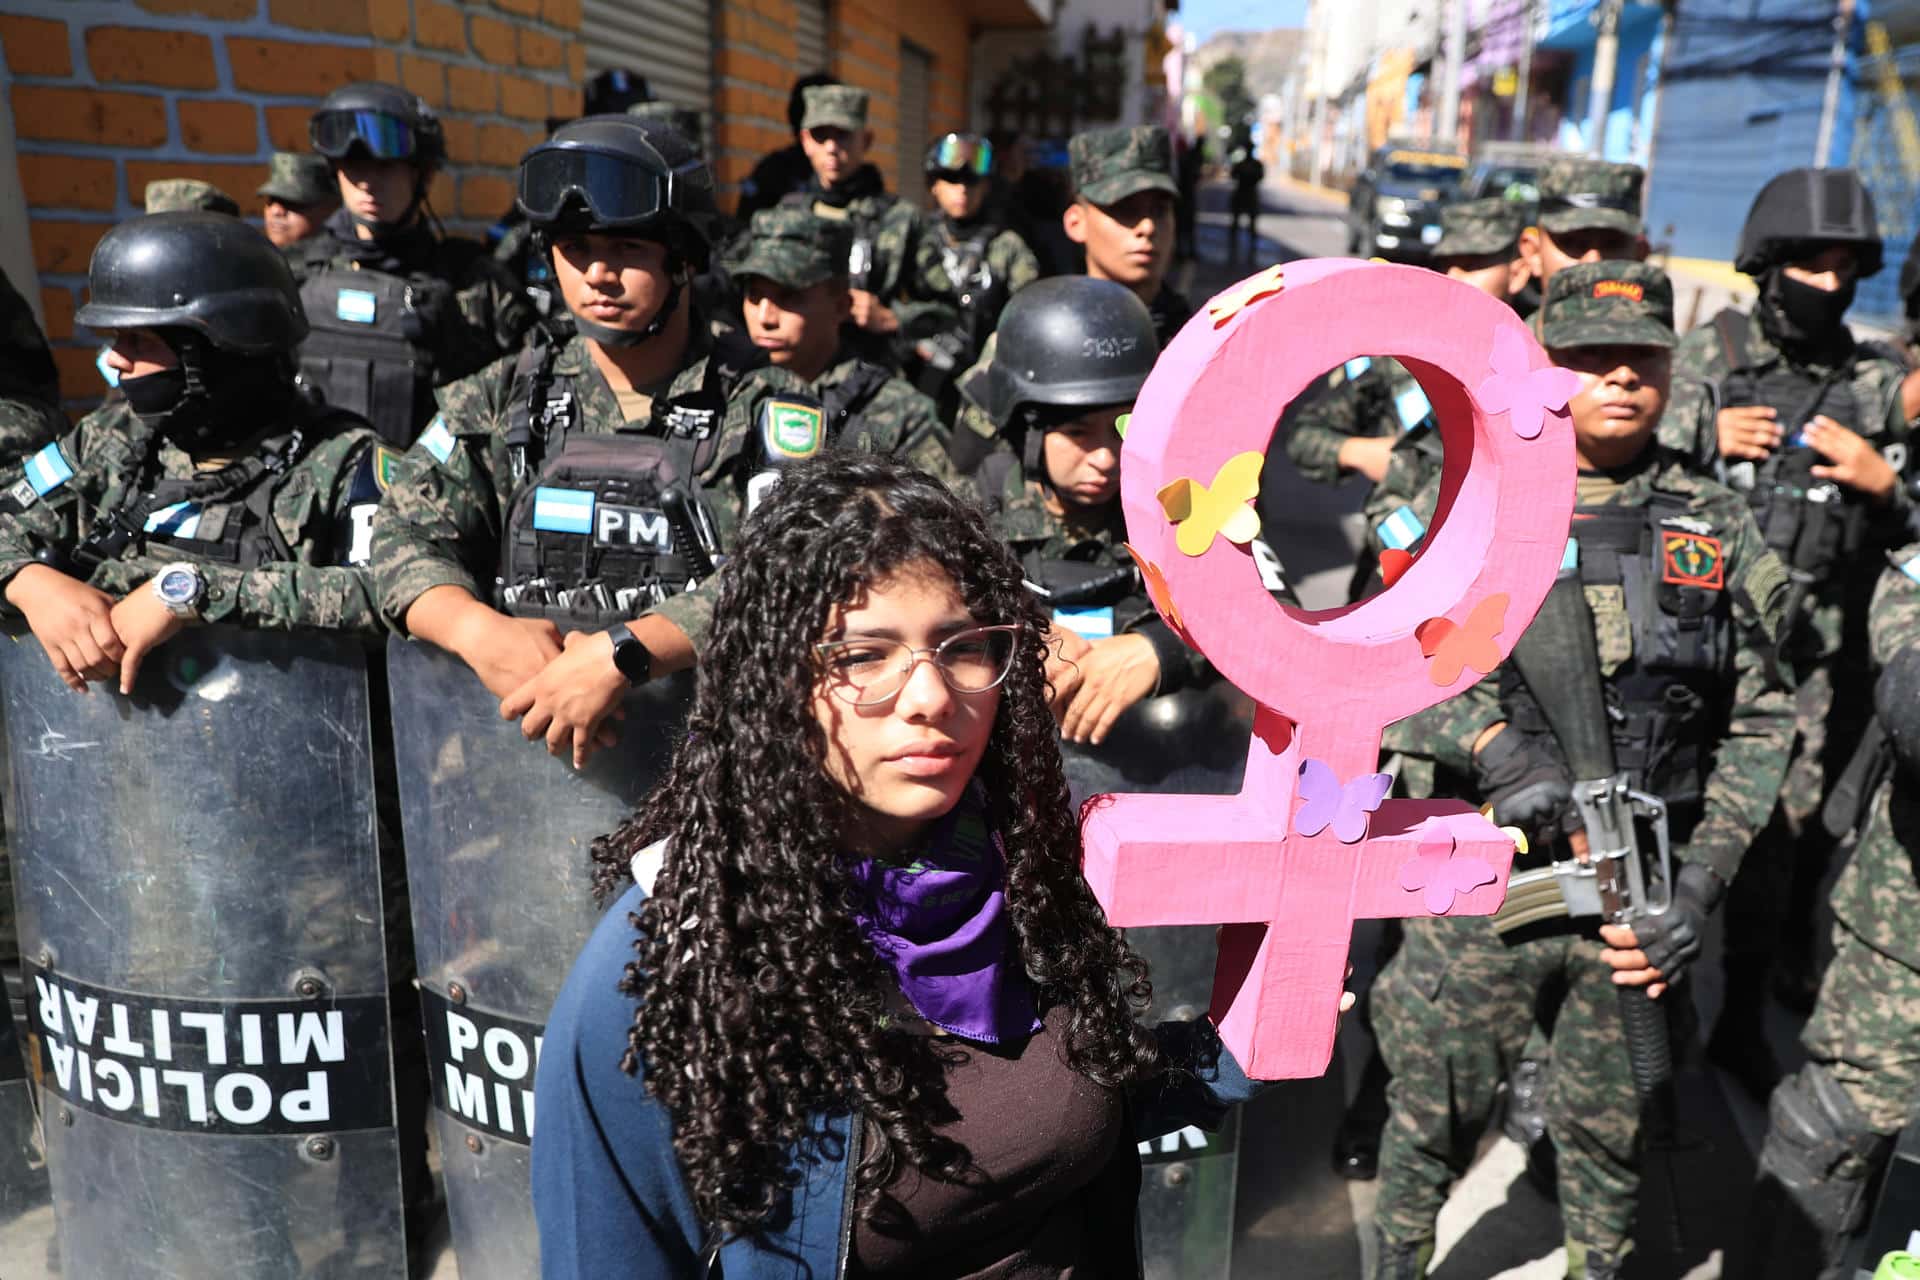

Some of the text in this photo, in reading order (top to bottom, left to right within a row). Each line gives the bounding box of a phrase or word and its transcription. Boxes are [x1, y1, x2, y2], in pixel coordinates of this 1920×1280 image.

[599, 508, 669, 546] PM
[35, 975, 345, 1065] MILITAR
[446, 1010, 544, 1080] PO
[46, 1035, 330, 1125] POLICIA
